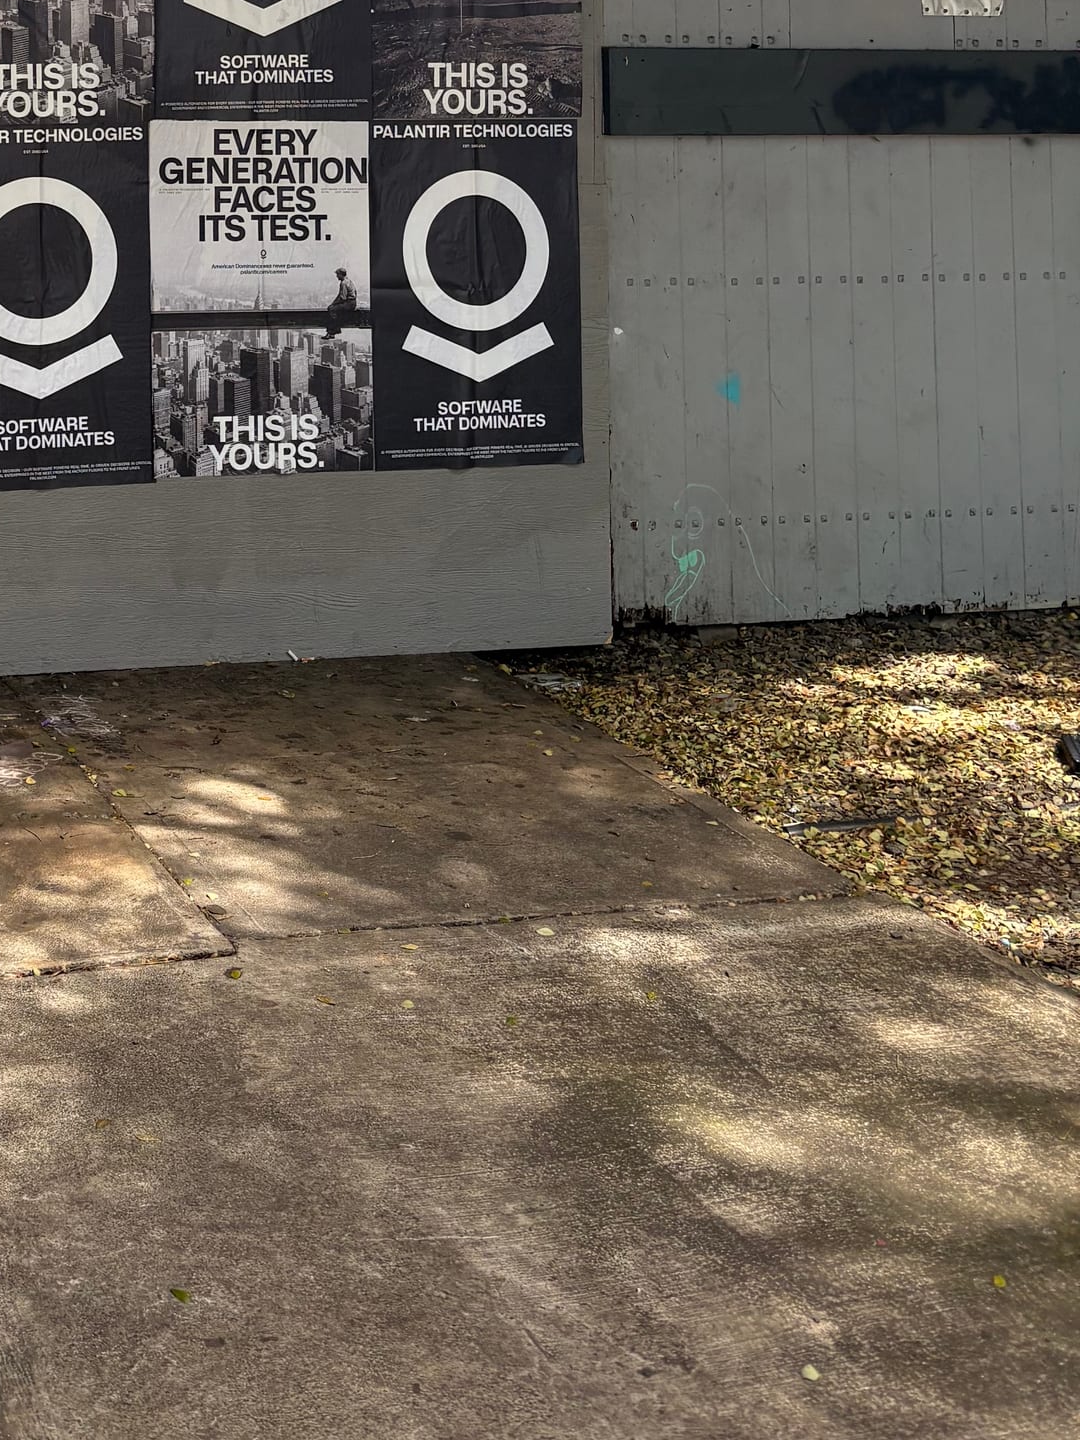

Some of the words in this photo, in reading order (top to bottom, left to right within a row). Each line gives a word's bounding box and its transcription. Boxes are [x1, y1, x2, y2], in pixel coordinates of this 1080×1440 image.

[220, 54, 308, 69] SOFTWARE
[72, 63, 99, 89] IS
[195, 71, 236, 84] THAT
[241, 69, 334, 84] DOMINATES
[428, 63, 495, 88] THIS
[502, 63, 528, 88] IS
[423, 90, 533, 115] YOURS.
[13, 127, 143, 143] TECHNOLOGIES
[214, 129, 317, 155] EVERY
[374, 125, 449, 138] PALANTIR
[454, 124, 572, 138] TECHNOLOGIES
[159, 158, 368, 184] GENERATION
[214, 186, 316, 212] FACES
[199, 215, 245, 241] ITS
[251, 215, 331, 241] TEST.
[438, 399, 522, 415] SOFTWARE
[213, 415, 285, 442] THIS
[292, 414, 319, 441] IS
[414, 417, 454, 432] THAT
[459, 414, 545, 431] DOMINATES
[16, 431, 114, 450] DOMINATES
[207, 442, 324, 470] YOURS.
